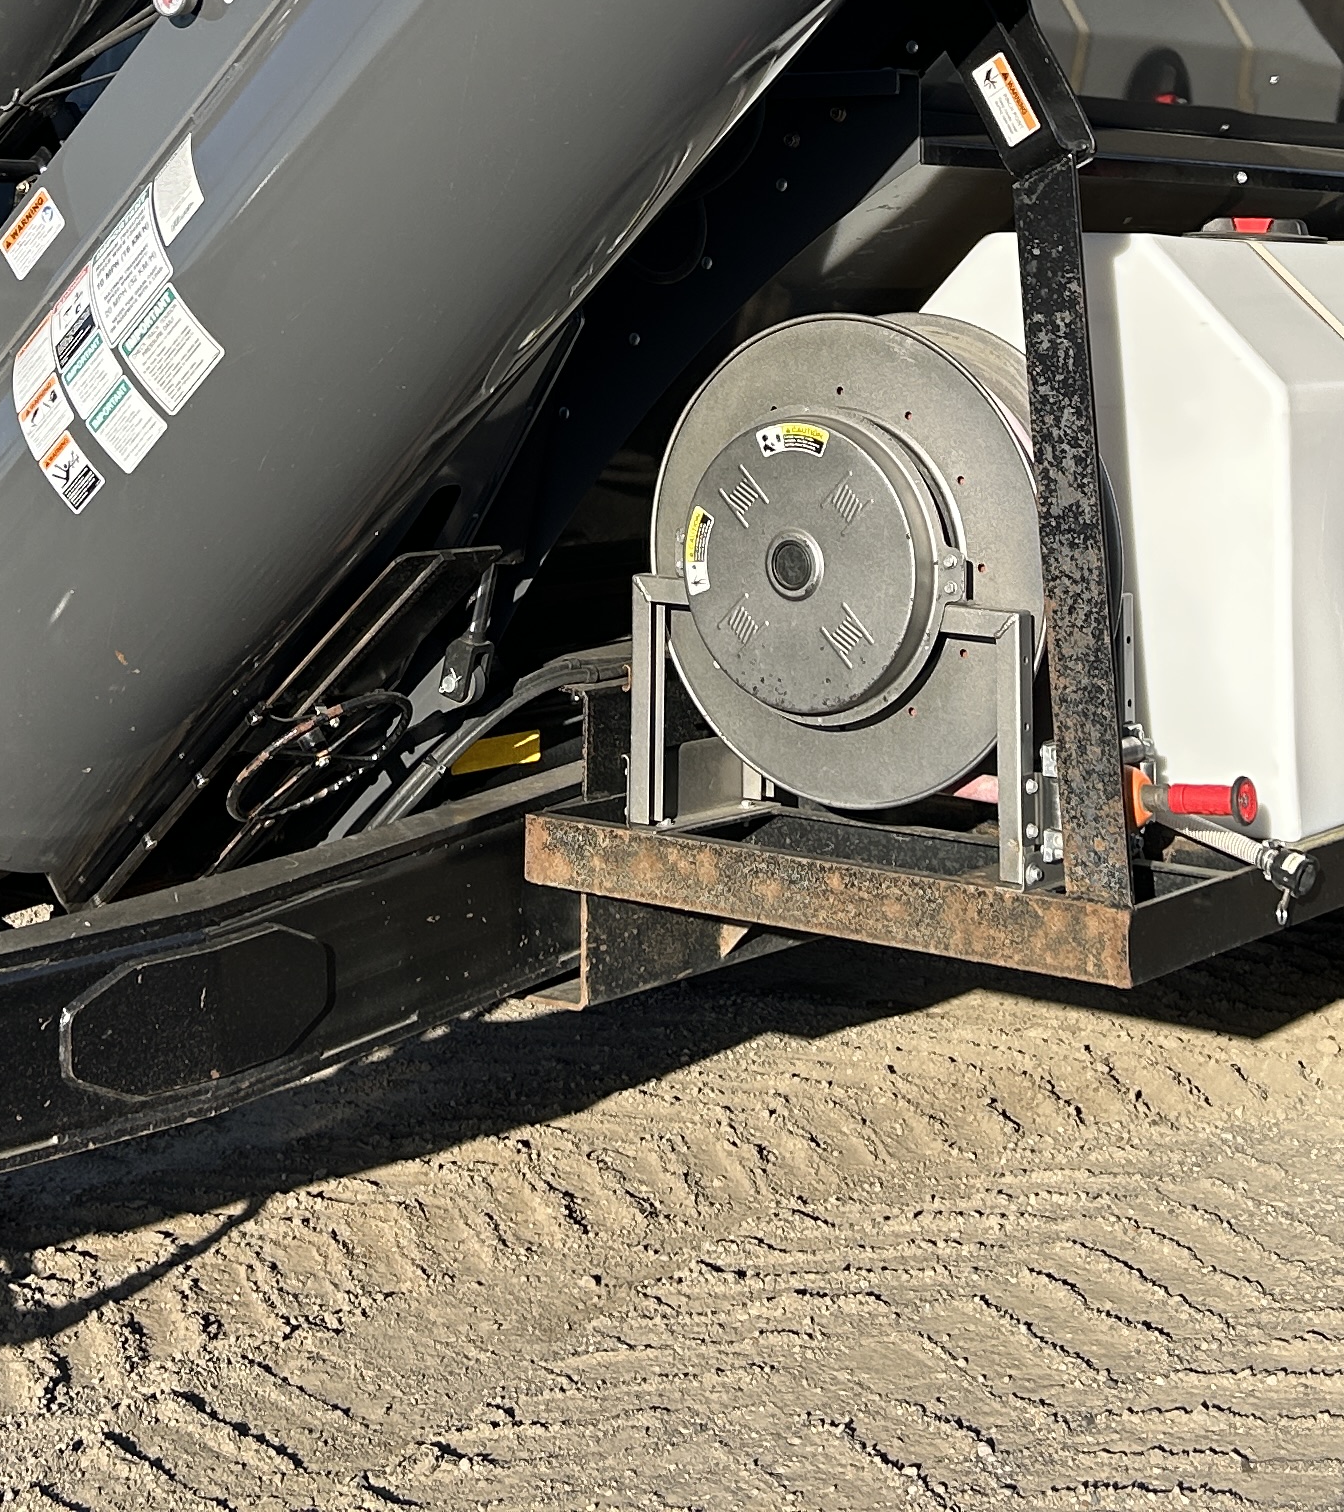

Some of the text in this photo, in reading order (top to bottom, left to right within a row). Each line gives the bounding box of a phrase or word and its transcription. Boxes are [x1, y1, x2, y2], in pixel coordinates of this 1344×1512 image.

[1007, 82, 1028, 115] WARNING
[10, 197, 44, 239] WARNING
[104, 257, 119, 281] MPH
[112, 285, 127, 308] MPH
[123, 289, 173, 353] IMPORTANT
[66, 337, 101, 382] IMPORTANT
[92, 383, 128, 430] IMPORTANT
[792, 426, 823, 439] CAUTION
[49, 439, 68, 463] WARNING
[689, 513, 700, 549] CAUTION
